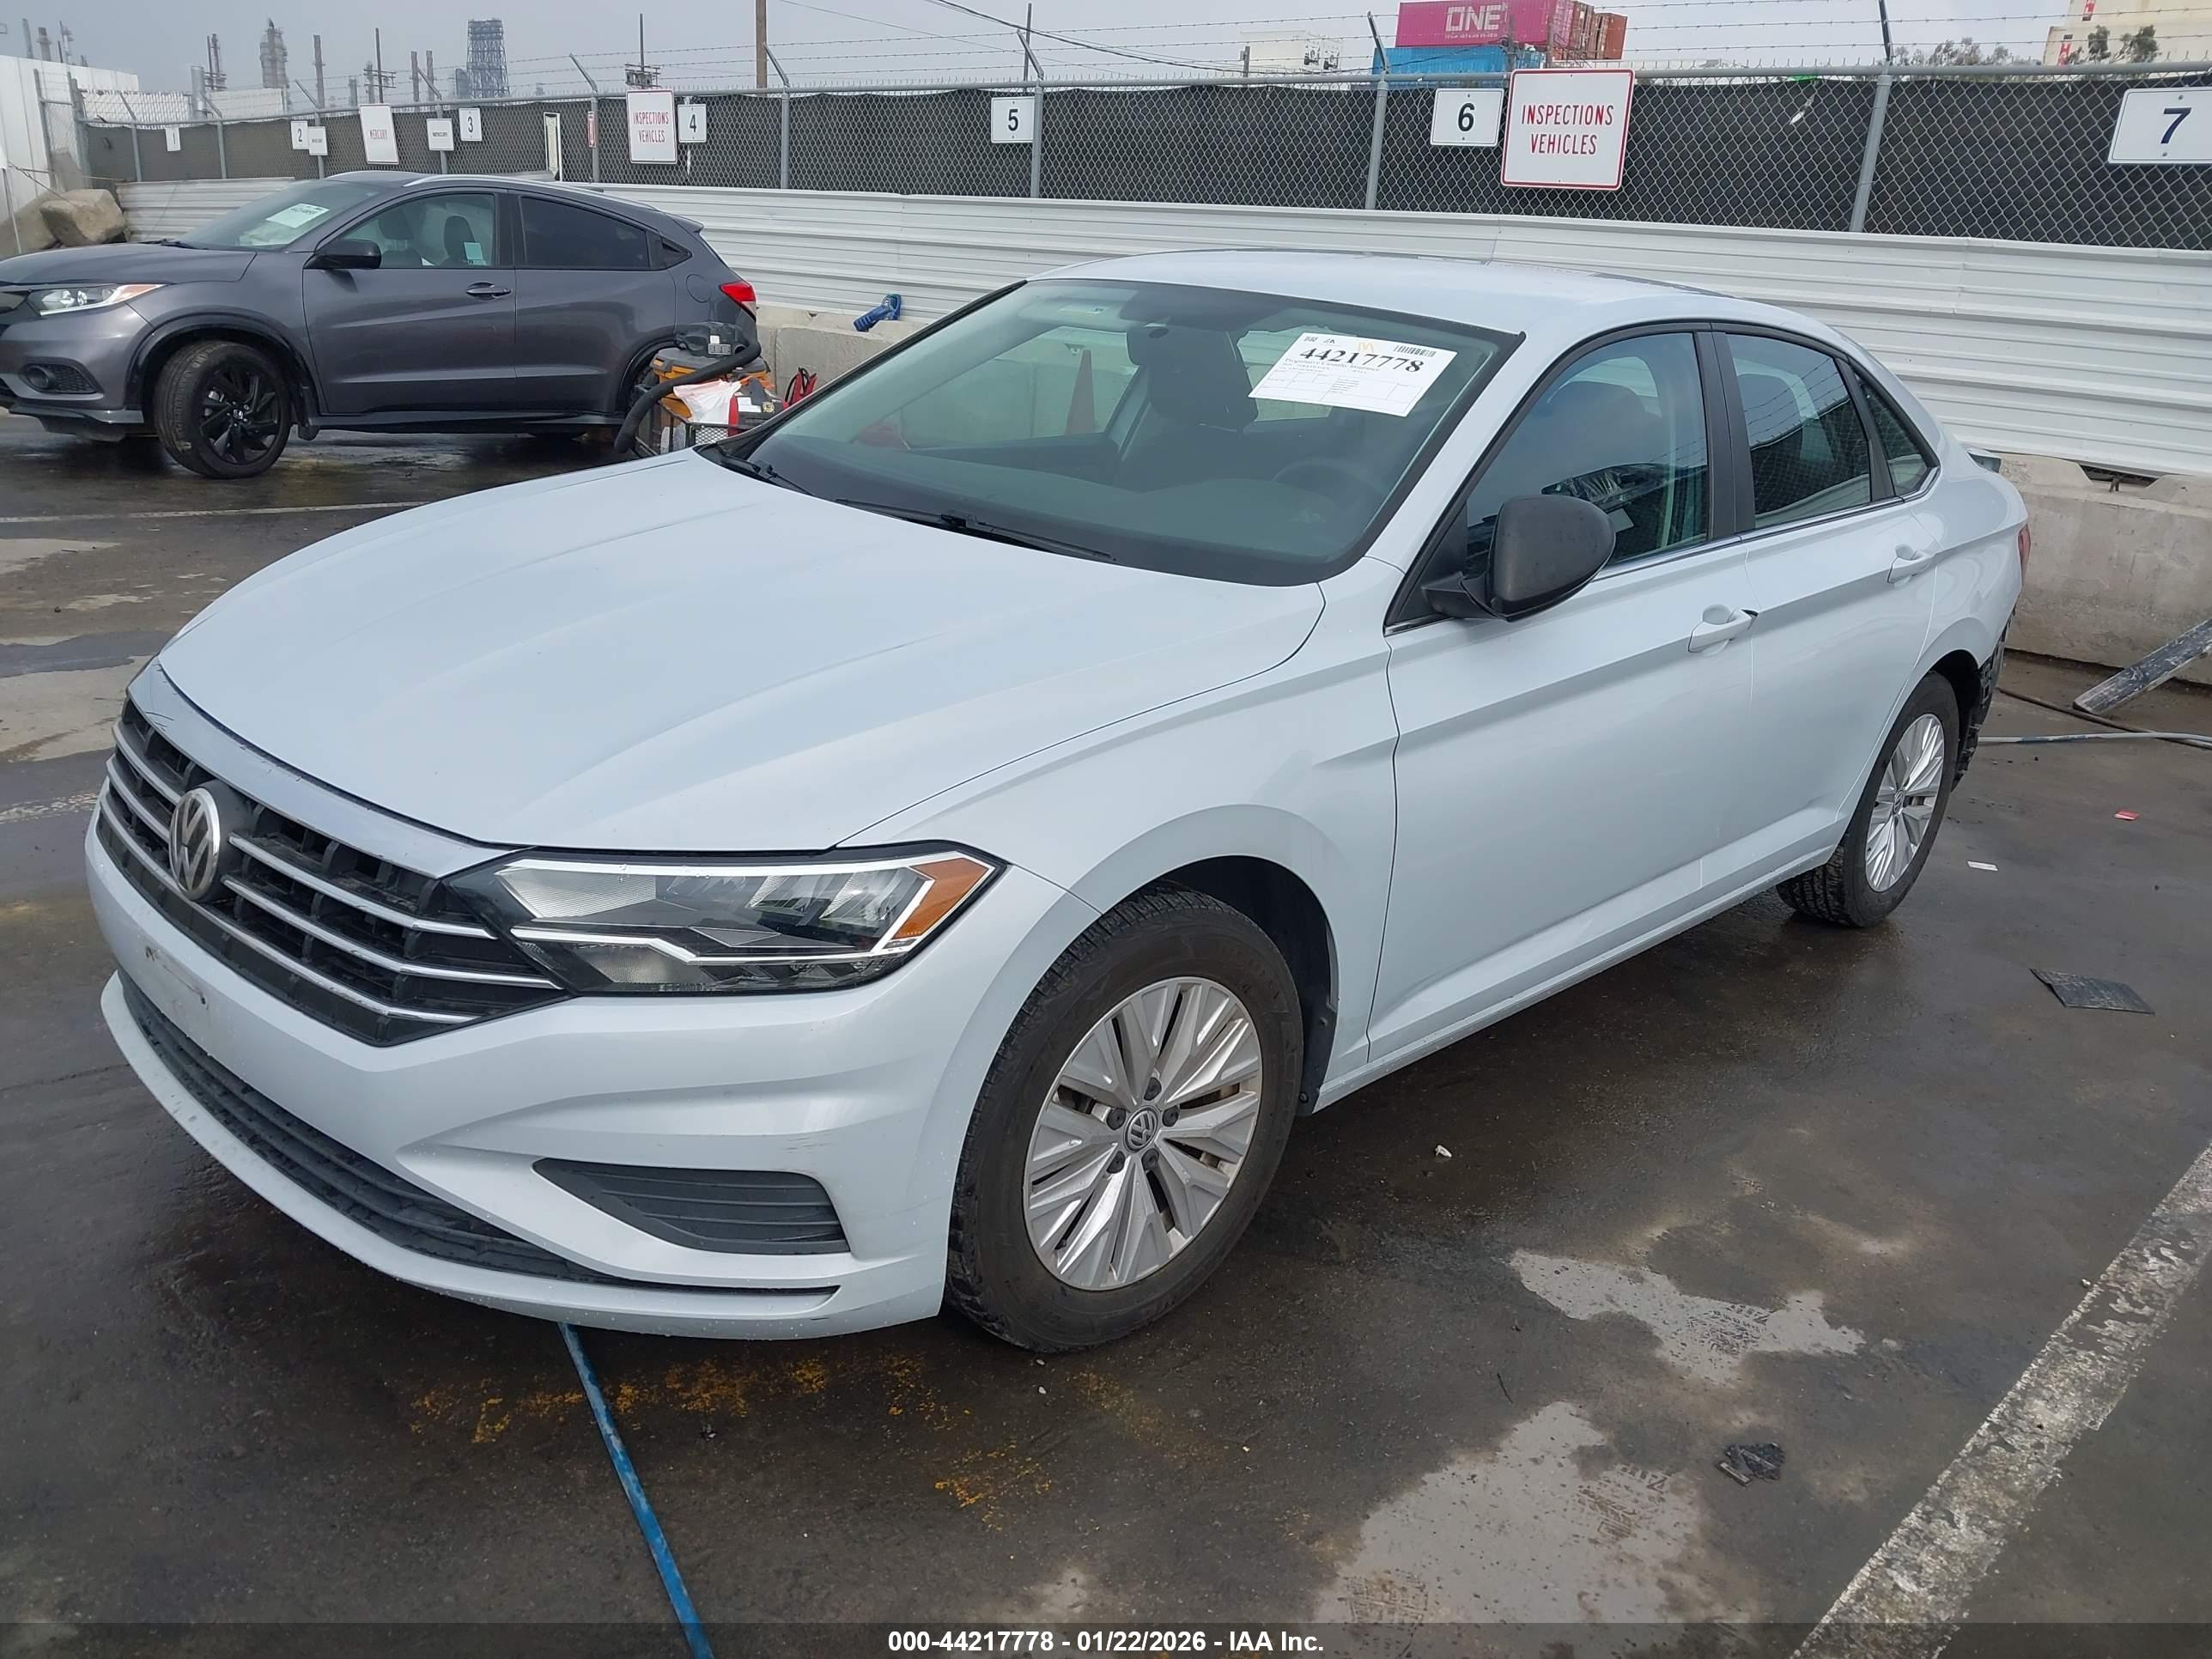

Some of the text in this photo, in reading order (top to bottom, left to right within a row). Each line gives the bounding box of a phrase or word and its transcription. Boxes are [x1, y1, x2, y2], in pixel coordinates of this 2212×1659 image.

[1445, 4, 1502, 32] ONE
[467, 116, 474, 132] 3
[633, 111, 669, 125] INSPECTIONS
[689, 113, 697, 133] 4
[1007, 108, 1019, 131] 5
[1457, 103, 1475, 131] 6
[1521, 105, 1614, 125] INSPECTIONS
[2160, 107, 2192, 144] 7
[297, 129, 303, 143] 2
[638, 130, 665, 143] VEHICLES
[1530, 134, 1598, 155] VEHICLES
[1299, 347, 1424, 373] 44217778
